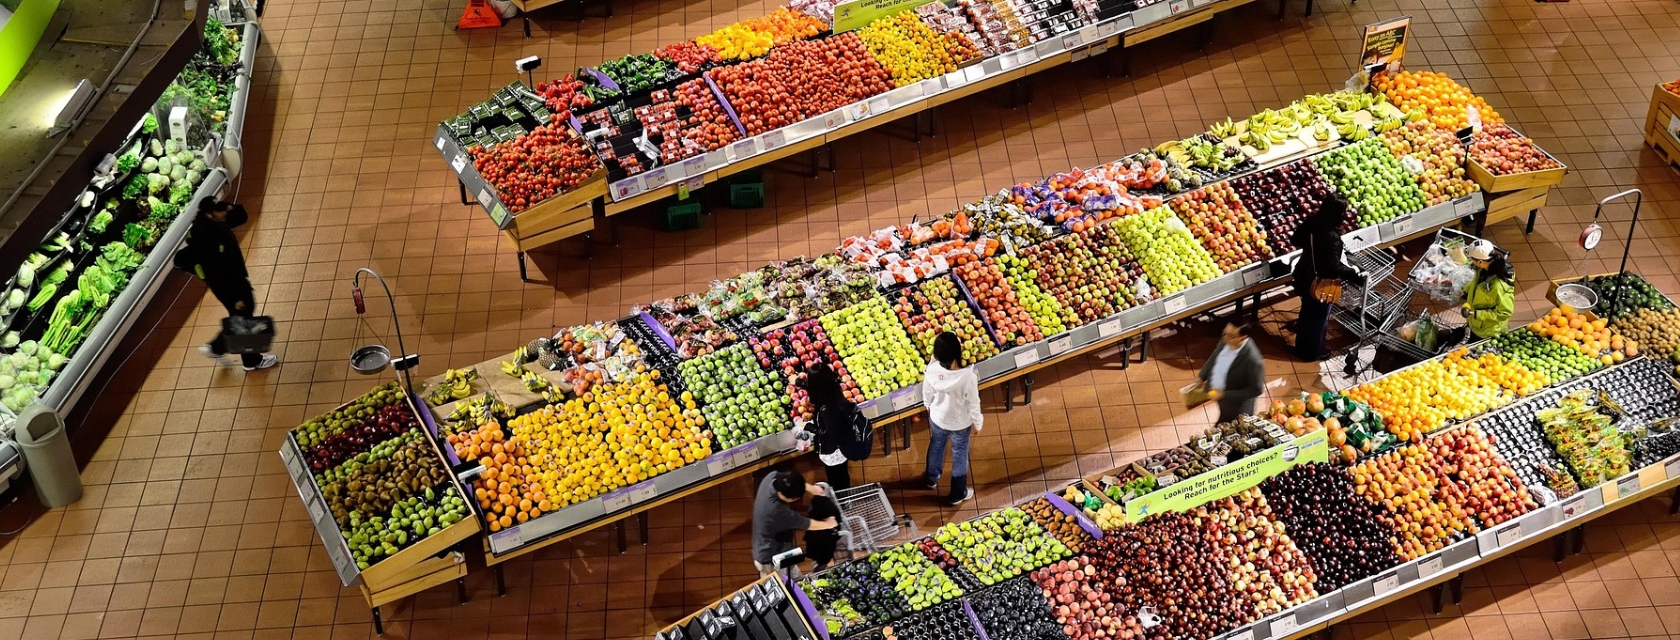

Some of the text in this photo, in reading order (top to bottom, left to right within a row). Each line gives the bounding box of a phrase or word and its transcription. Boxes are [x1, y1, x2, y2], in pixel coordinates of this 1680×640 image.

[861, 0, 883, 8] Looking
[1163, 485, 1193, 500] Looking
[1195, 480, 1205, 489] for
[1208, 466, 1244, 483] nutritious
[1247, 452, 1278, 469] choices?
[1184, 487, 1208, 500] Reach
[1209, 482, 1220, 490] for
[1222, 477, 1234, 486] the
[1236, 467, 1259, 480] Stars!
